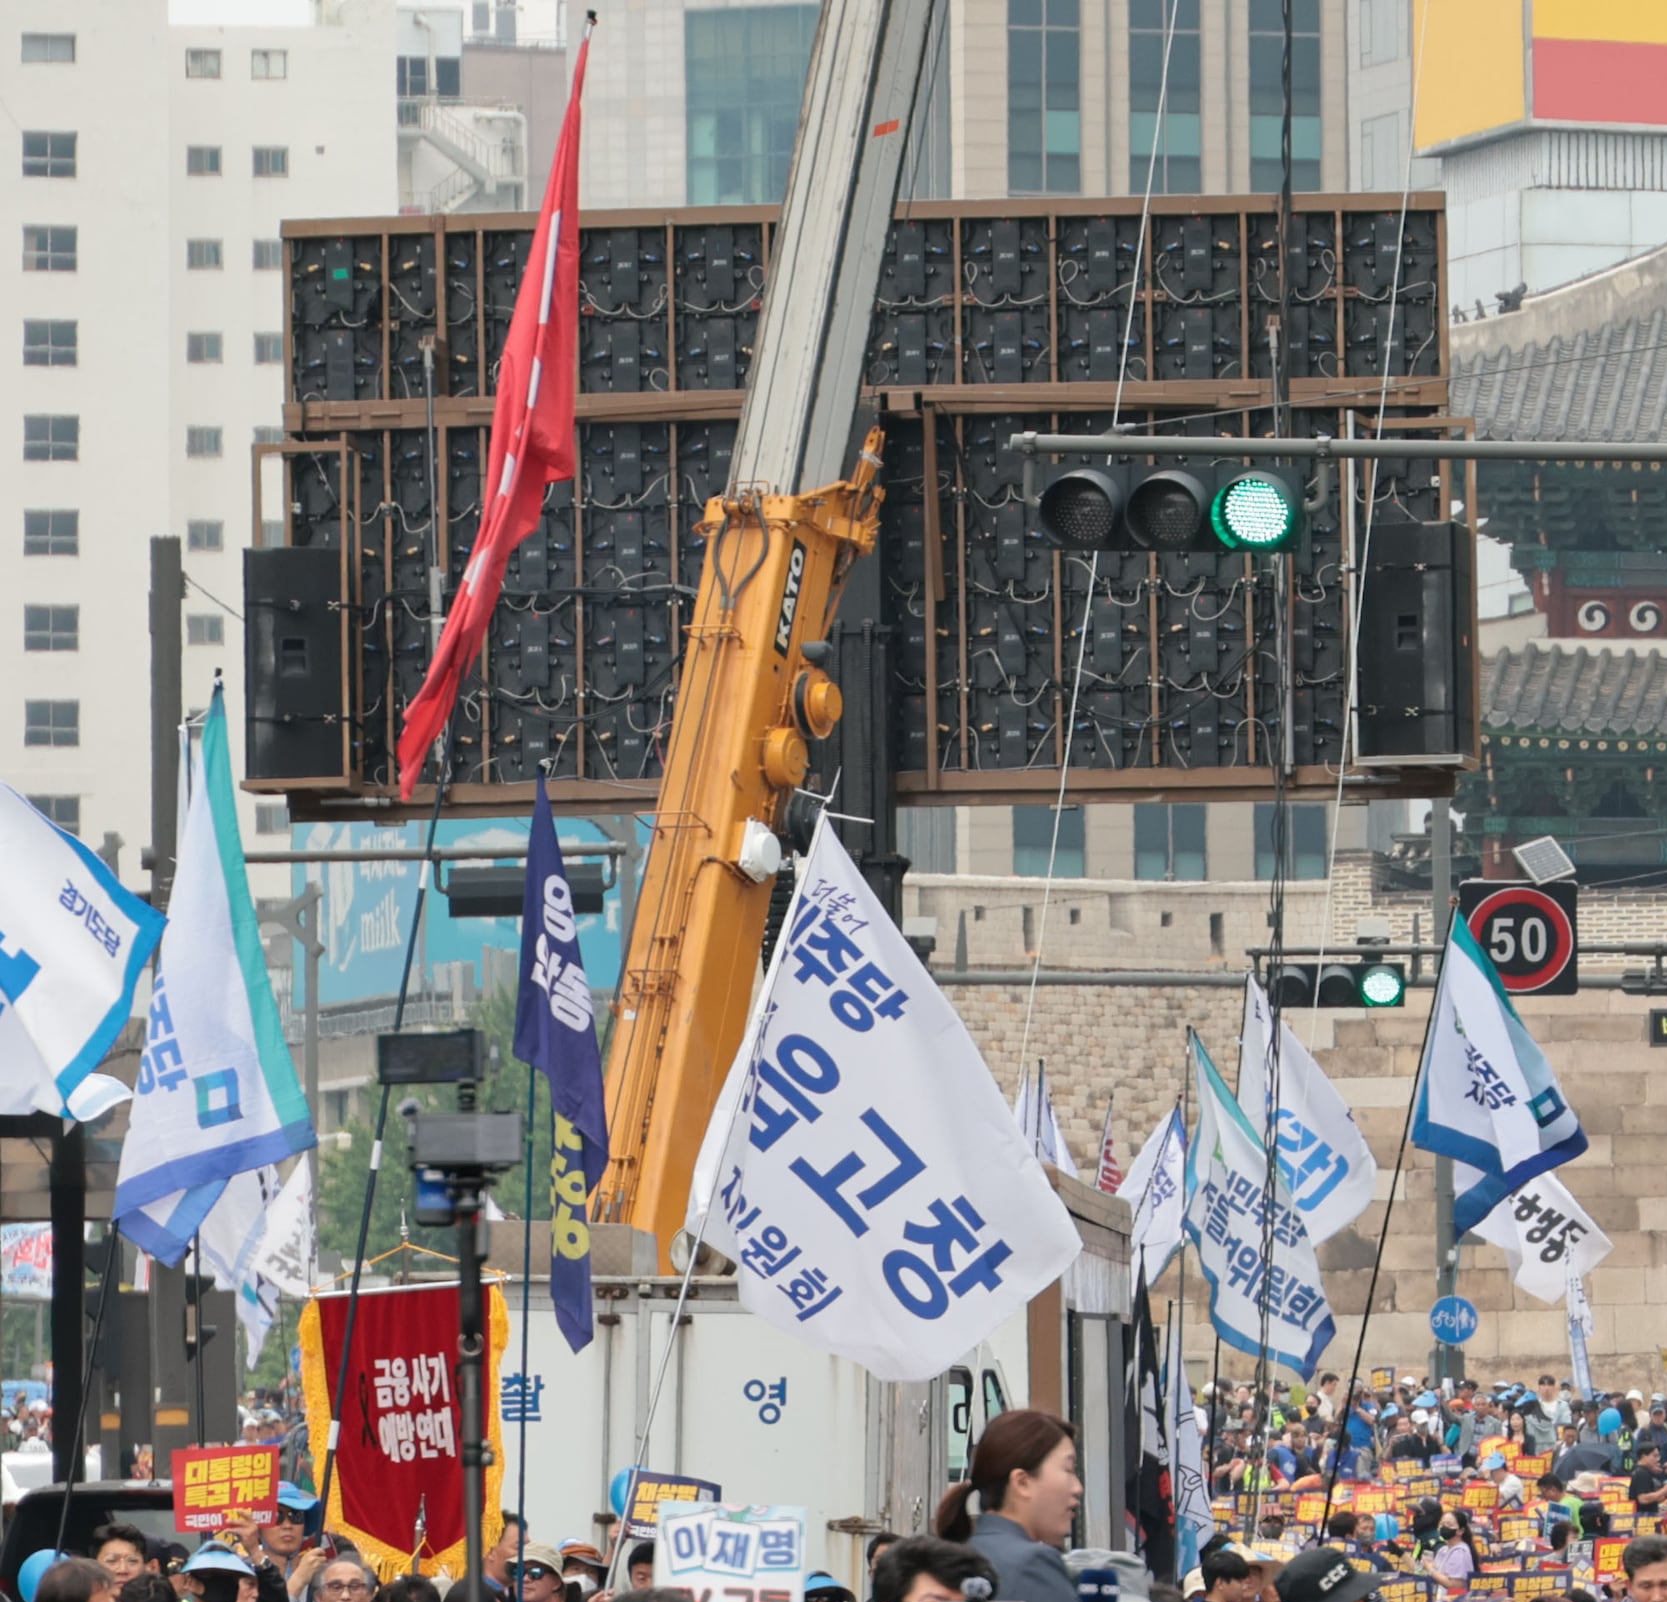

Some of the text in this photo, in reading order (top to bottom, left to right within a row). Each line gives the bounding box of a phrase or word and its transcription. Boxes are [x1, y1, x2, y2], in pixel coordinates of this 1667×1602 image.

[777, 549, 803, 648] KATO
[1490, 917, 1547, 962] 50
[743, 1377, 786, 1424] 영
[185, 1453, 272, 1485] 대통령의
[185, 1477, 270, 1508] 특검 거부
[185, 1512, 222, 1528] 국민이
[674, 1522, 794, 1570] 이재명
